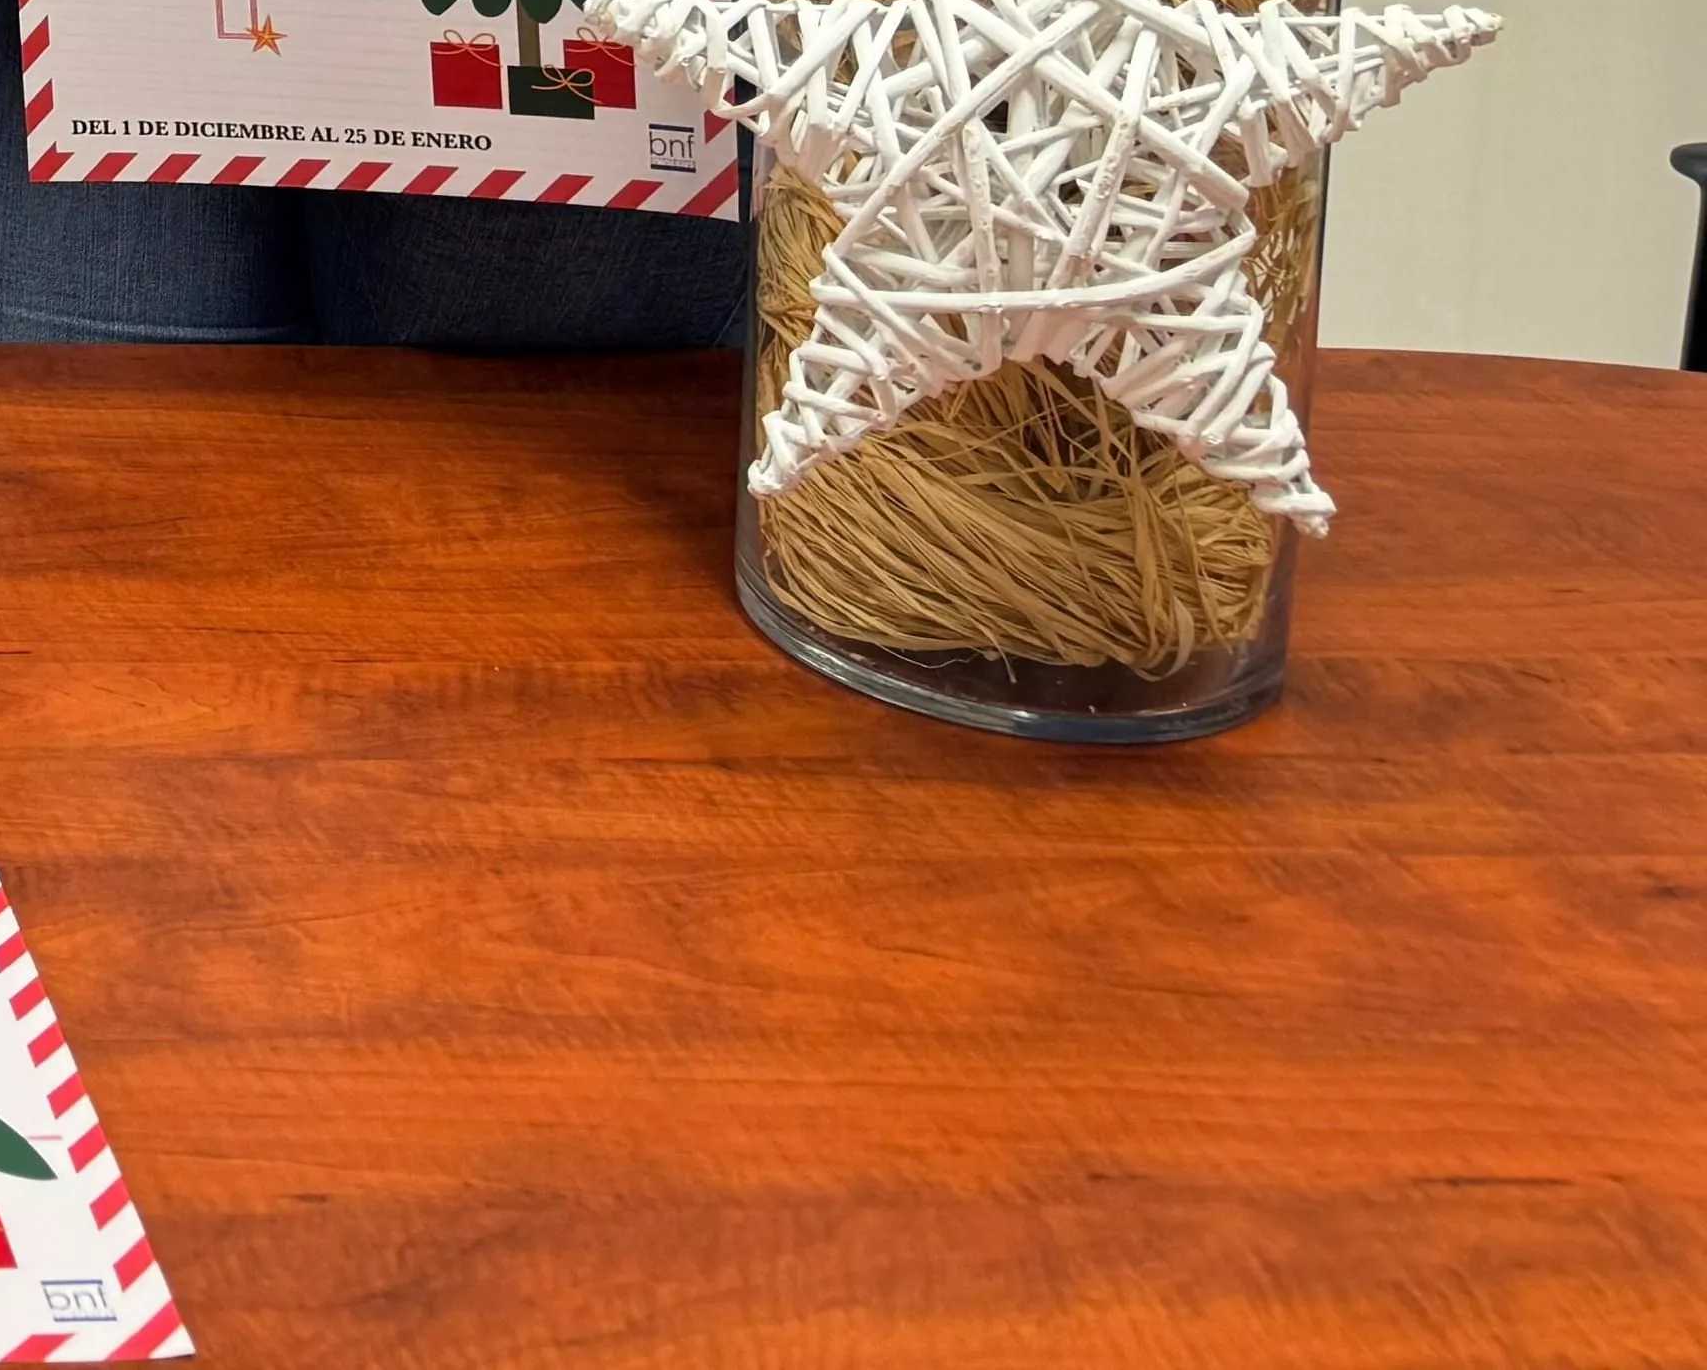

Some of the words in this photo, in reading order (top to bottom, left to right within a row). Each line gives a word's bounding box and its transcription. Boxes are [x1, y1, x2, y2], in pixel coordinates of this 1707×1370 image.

[71, 119, 116, 135] DEL
[122, 119, 131, 135] 1
[137, 119, 169, 136] DE
[173, 120, 305, 141] DICIEMBRE
[310, 126, 339, 143] AL
[343, 127, 367, 144] 25
[372, 128, 406, 146] DE
[410, 131, 492, 151] ENERO
[649, 130, 695, 157] bnf
